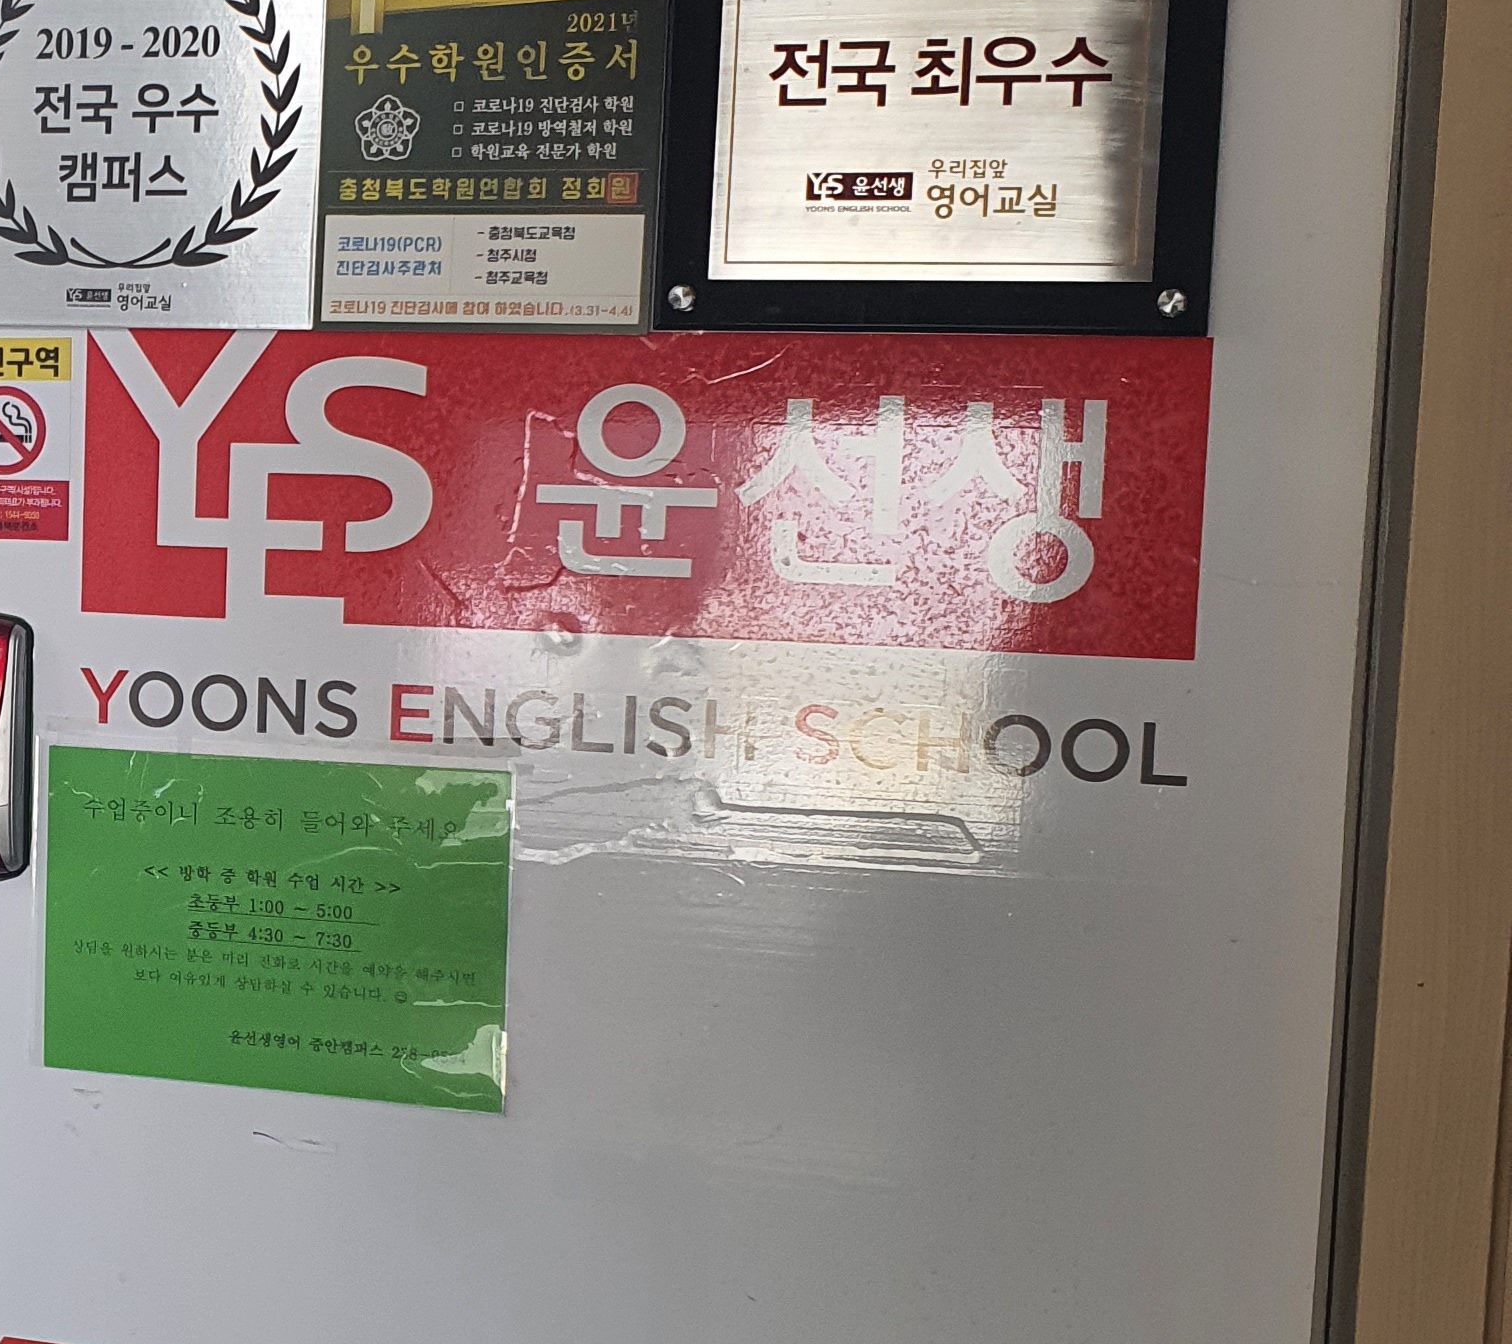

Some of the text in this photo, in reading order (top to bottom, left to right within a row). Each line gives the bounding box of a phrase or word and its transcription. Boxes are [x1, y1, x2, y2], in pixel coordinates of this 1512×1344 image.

[567, 10, 638, 33] 2021년
[36, 27, 112, 60] 2019
[142, 25, 221, 58] 2020
[344, 39, 638, 85] 우수학원인증서
[769, 36, 1114, 107] 전국 최우수
[34, 83, 219, 134] 전국 우수
[471, 95, 634, 115] 코로나19 진단검사 학원
[471, 118, 633, 137] 코로나19 방역철저 학원
[470, 142, 617, 161] 학원교육 전문가 학원
[59, 151, 188, 203] 캠퍼스
[928, 159, 1008, 179] 우리집앞
[339, 176, 630, 201] 충청북도학원연합회 정회원
[852, 177, 906, 197] 윤선생
[805, 205, 912, 213] YOONS ENGLISH SCHOOL
[927, 184, 1058, 219] 영어교실
[337, 236, 442, 254] 코로나19(PCR)
[488, 225, 576, 241] 충청북도교육청
[487, 248, 537, 263] 청주시청
[336, 260, 442, 277] 진단검사주관처
[485, 270, 548, 285] 청주교육청
[117, 294, 171, 311] 영어교실
[329, 300, 387, 315] 코로나19
[390, 300, 458, 315] 진단검사에
[462, 301, 489, 315] 참여
[535, 383, 1108, 605] 윤선생
[81, 666, 1189, 788] YOONS ENGLISH SCHOOL
[83, 797, 197, 826] 수업중이니
[213, 806, 282, 832] 조용히
[300, 810, 374, 838] 들어와
[179, 864, 211, 883] 방학
[220, 867, 236, 885] 중
[246, 868, 277, 888] 학원
[288, 872, 319, 891] 수업
[331, 874, 364, 895] 시간
[188, 893, 239, 913] 초등부
[249, 898, 284, 915] 1:00
[316, 903, 353, 920] 5:00
[188, 921, 239, 941] 중등부
[248, 926, 284, 943] 4:30
[316, 931, 352, 948] 7:30
[74, 939, 114, 956] 상담을
[121, 942, 178, 961] 원하시는
[222, 950, 249, 967] 미리
[309, 958, 354, 976] 시간을
[134, 968, 161, 983] 보다
[300, 982, 314, 996] 수
[228, 1029, 301, 1050] 윤선생영어
